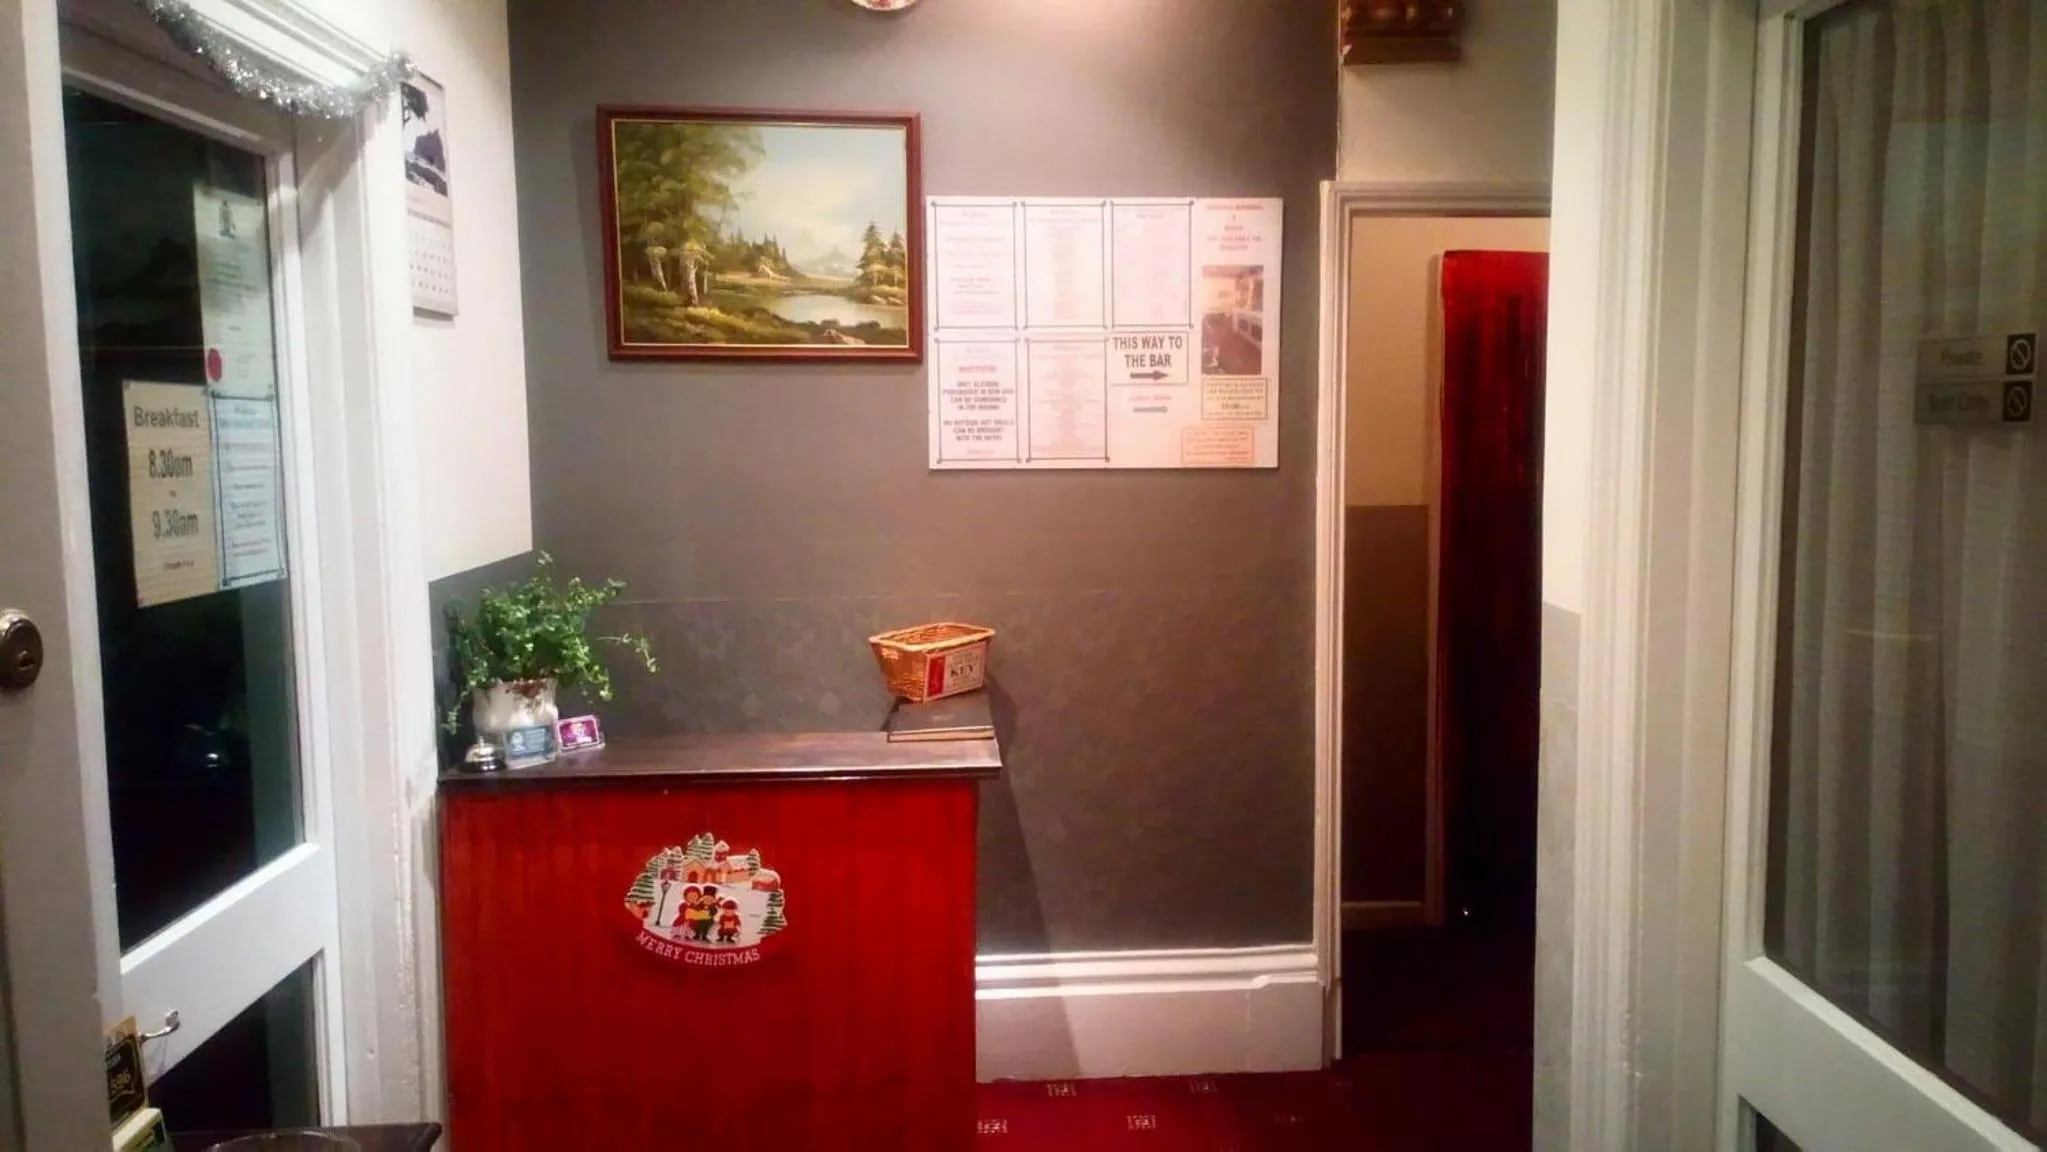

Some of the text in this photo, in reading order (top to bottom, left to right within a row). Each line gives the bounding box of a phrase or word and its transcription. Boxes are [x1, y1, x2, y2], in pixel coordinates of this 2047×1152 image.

[1113, 336, 1183, 350] THIS WAY TO
[1124, 354, 1172, 368] THE BAR
[133, 406, 200, 429] Breakfast
[148, 449, 193, 479] 8.30am
[152, 509, 200, 540] 9.30am
[635, 931, 761, 967] MERRY CHRISTMAS
